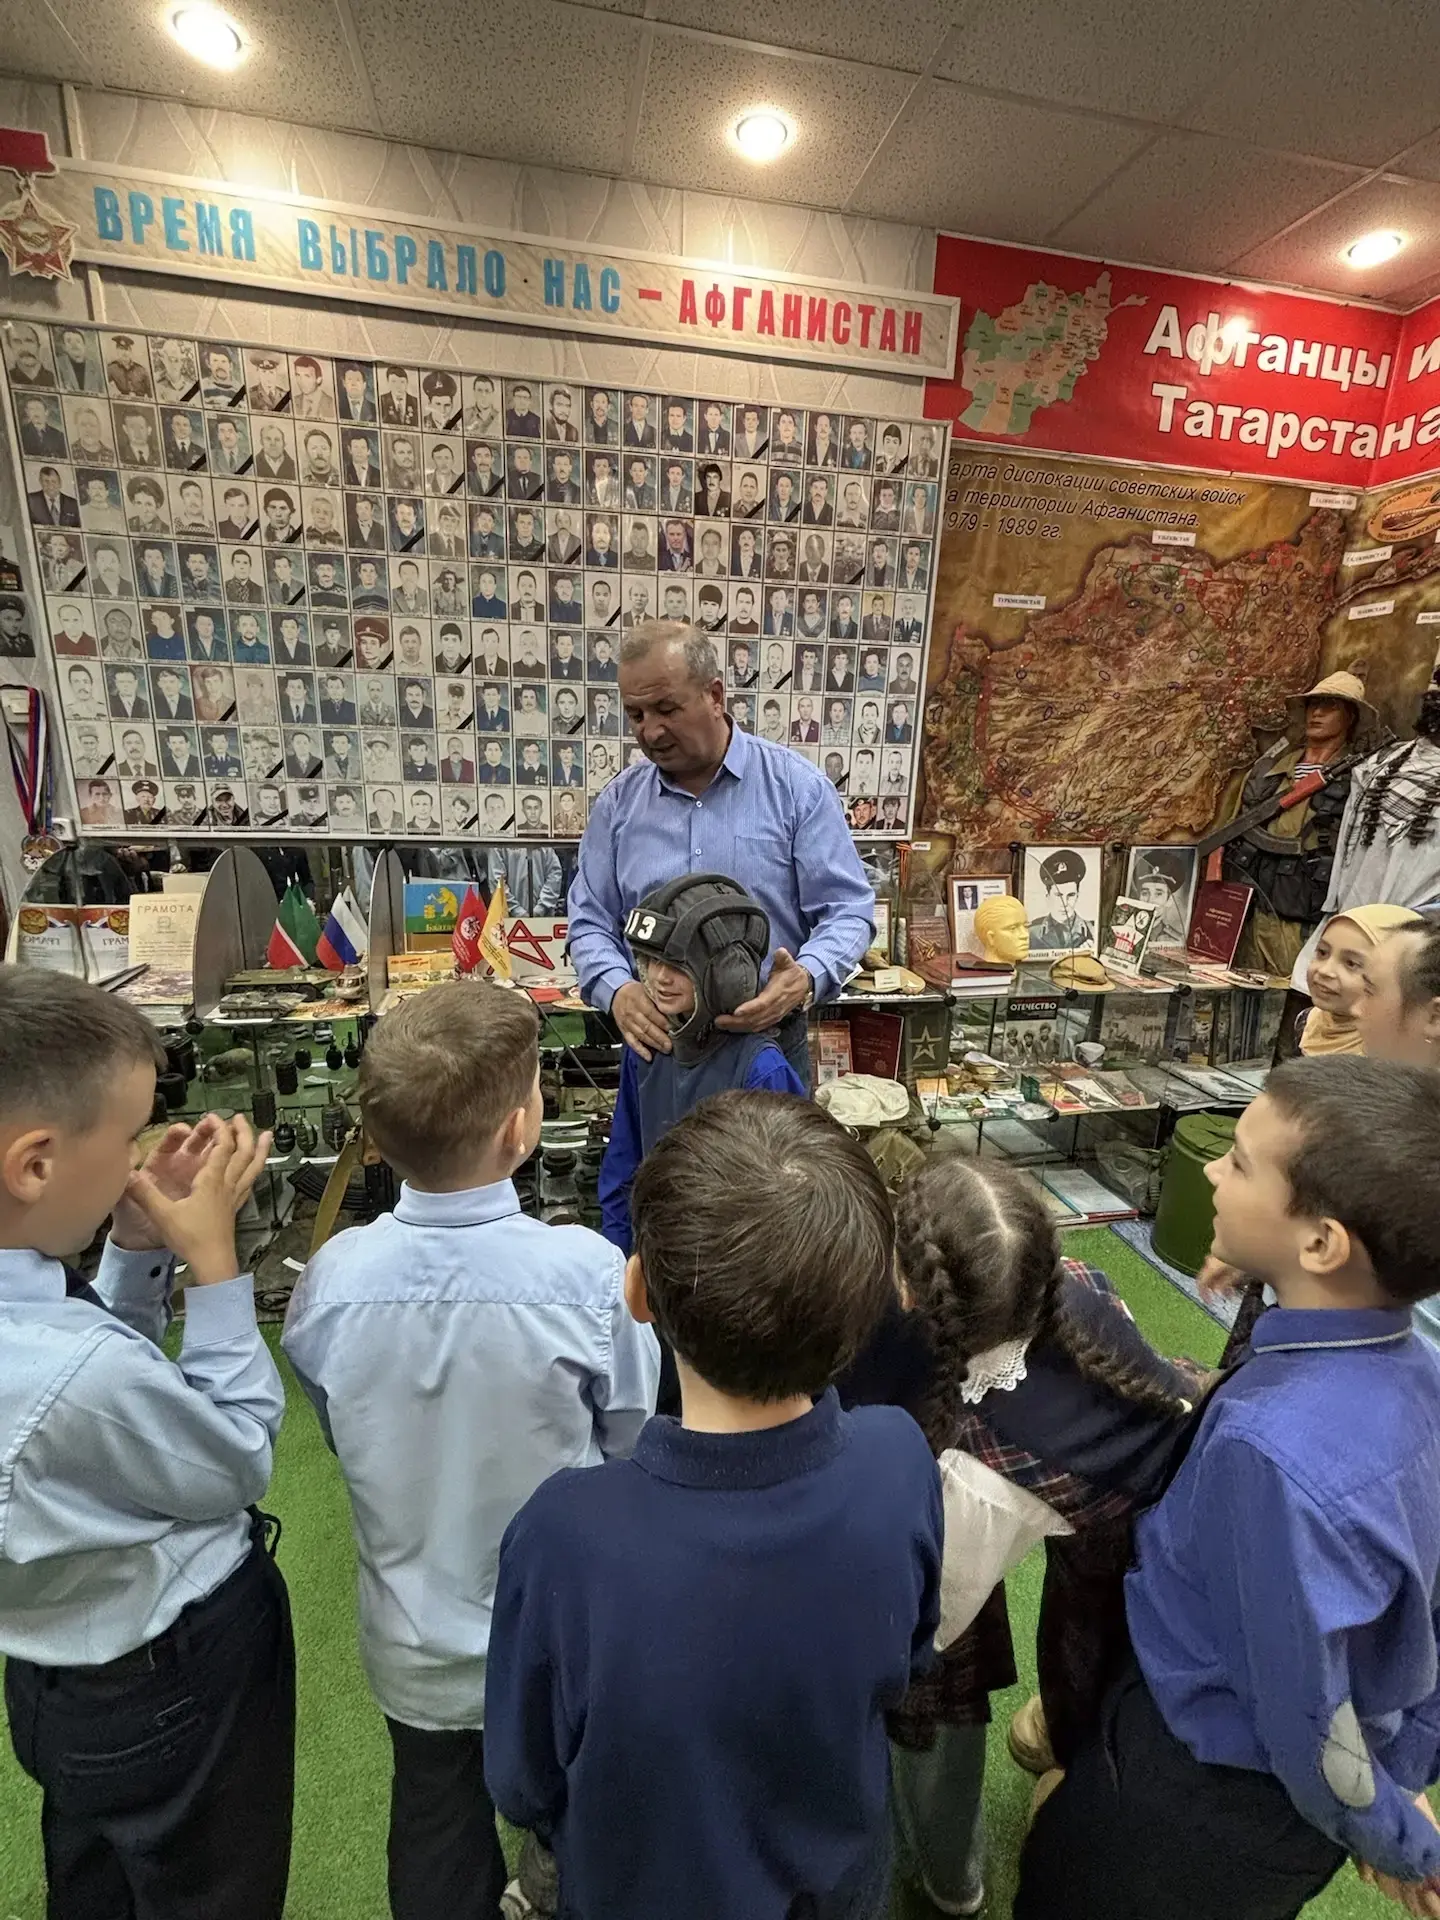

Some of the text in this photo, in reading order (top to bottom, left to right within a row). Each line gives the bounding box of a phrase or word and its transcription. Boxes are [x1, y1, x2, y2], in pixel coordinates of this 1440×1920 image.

[94, 187, 257, 261] ВРЕМЯ
[298, 218, 507, 298] ВЫБРАЛО
[544, 260, 621, 313] НАС
[679, 279, 923, 355] АФГАНИСТАН
[1144, 305, 1393, 390] Афганцы
[1151, 382, 1440, 460] Татарстана
[950, 461, 1246, 506] арта дислокации советских войск
[944, 488, 1200, 527] а территории Афганистана.
[998, 516, 1038, 536] 1989
[1041, 525, 1062, 539] гг.
[137, 904, 194, 914] ГРАМОТА
[1010, 1002, 1057, 1012] ОТЕЧЕСТВО
